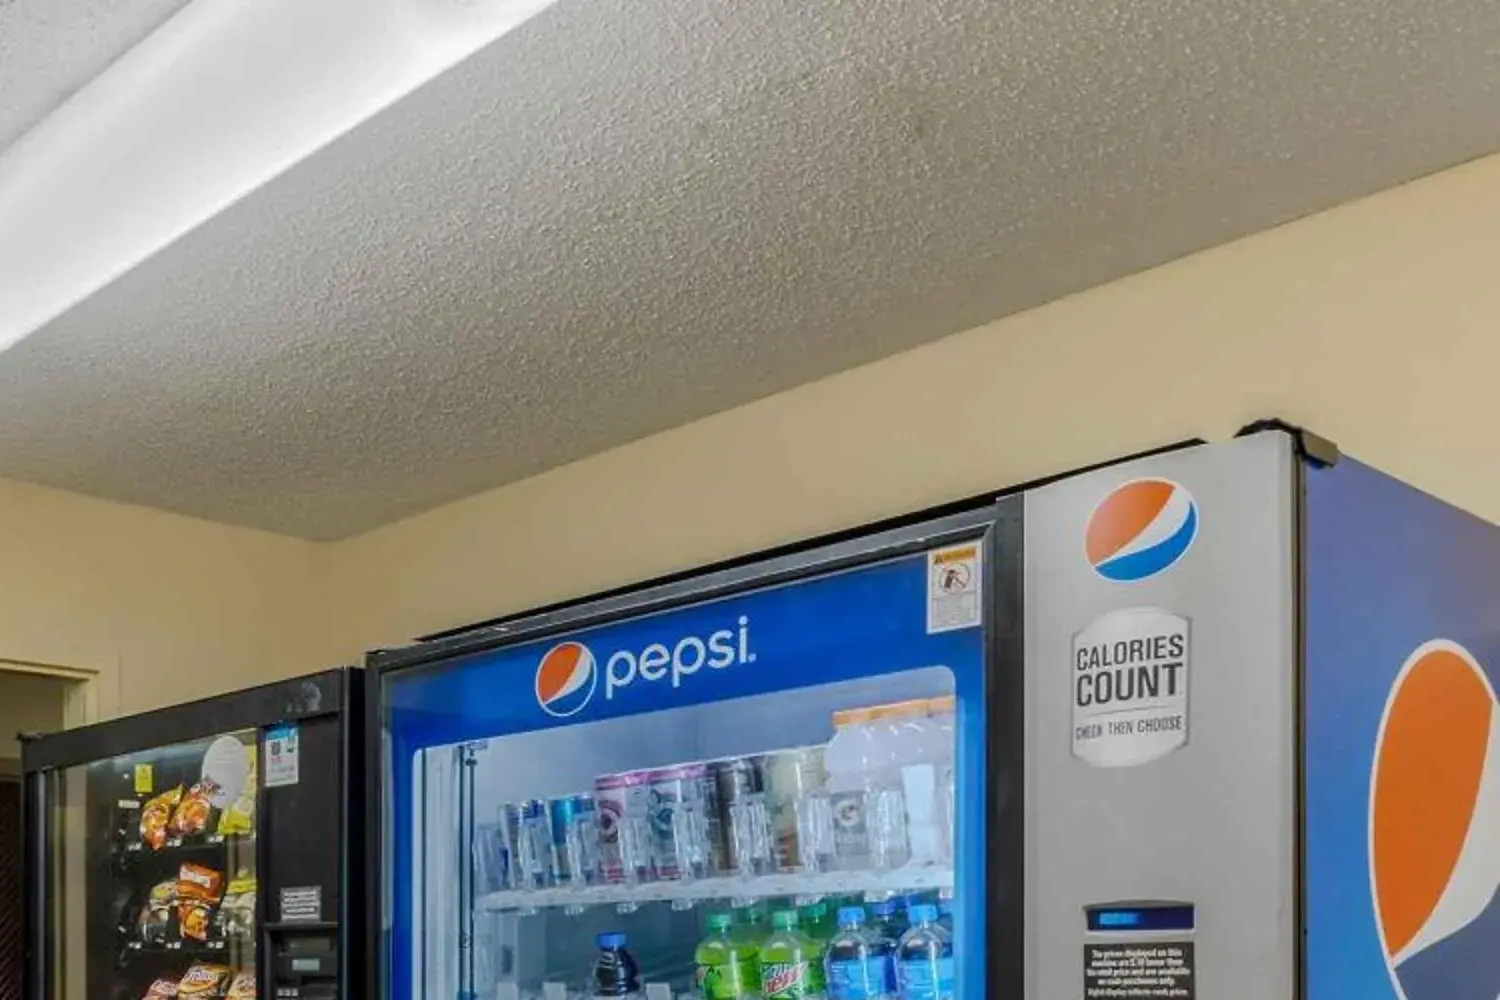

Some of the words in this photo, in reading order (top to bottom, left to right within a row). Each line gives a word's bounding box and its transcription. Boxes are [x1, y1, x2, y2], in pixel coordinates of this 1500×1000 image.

[606, 615, 749, 700] pepsi
[1076, 633, 1185, 671] CALORIES
[1076, 661, 1184, 707] COUNT
[1137, 715, 1183, 733] CHOOSE
